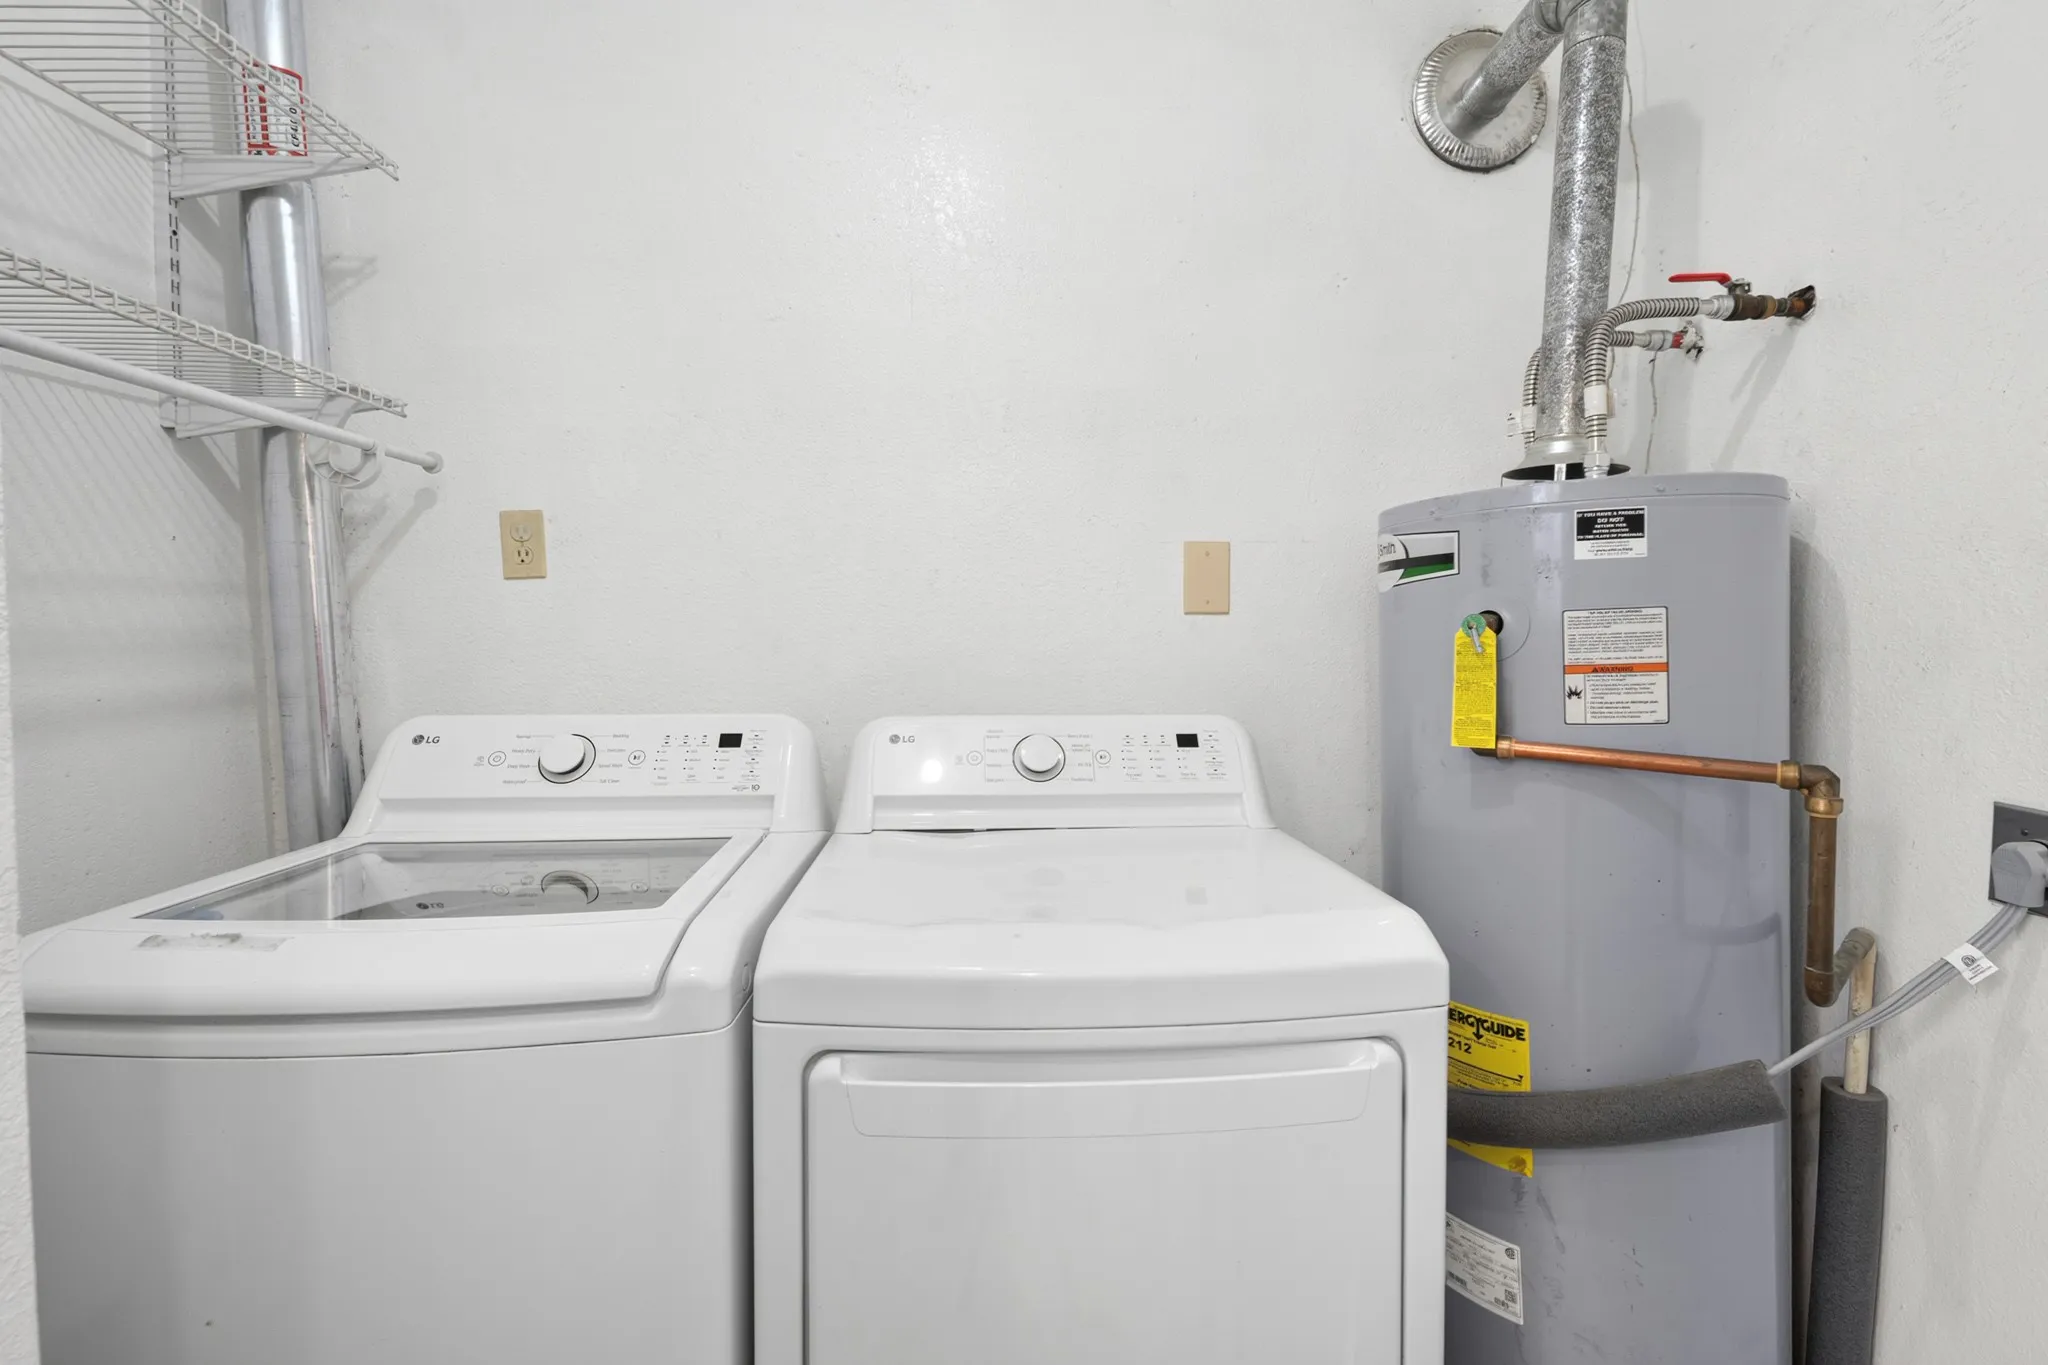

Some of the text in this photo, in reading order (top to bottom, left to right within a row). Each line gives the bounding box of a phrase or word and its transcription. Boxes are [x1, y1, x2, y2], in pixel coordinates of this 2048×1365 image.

[425, 736, 440, 744] LG
[902, 735, 915, 743] LG
[1449, 1007, 1526, 1042] ERGYGUIDE
